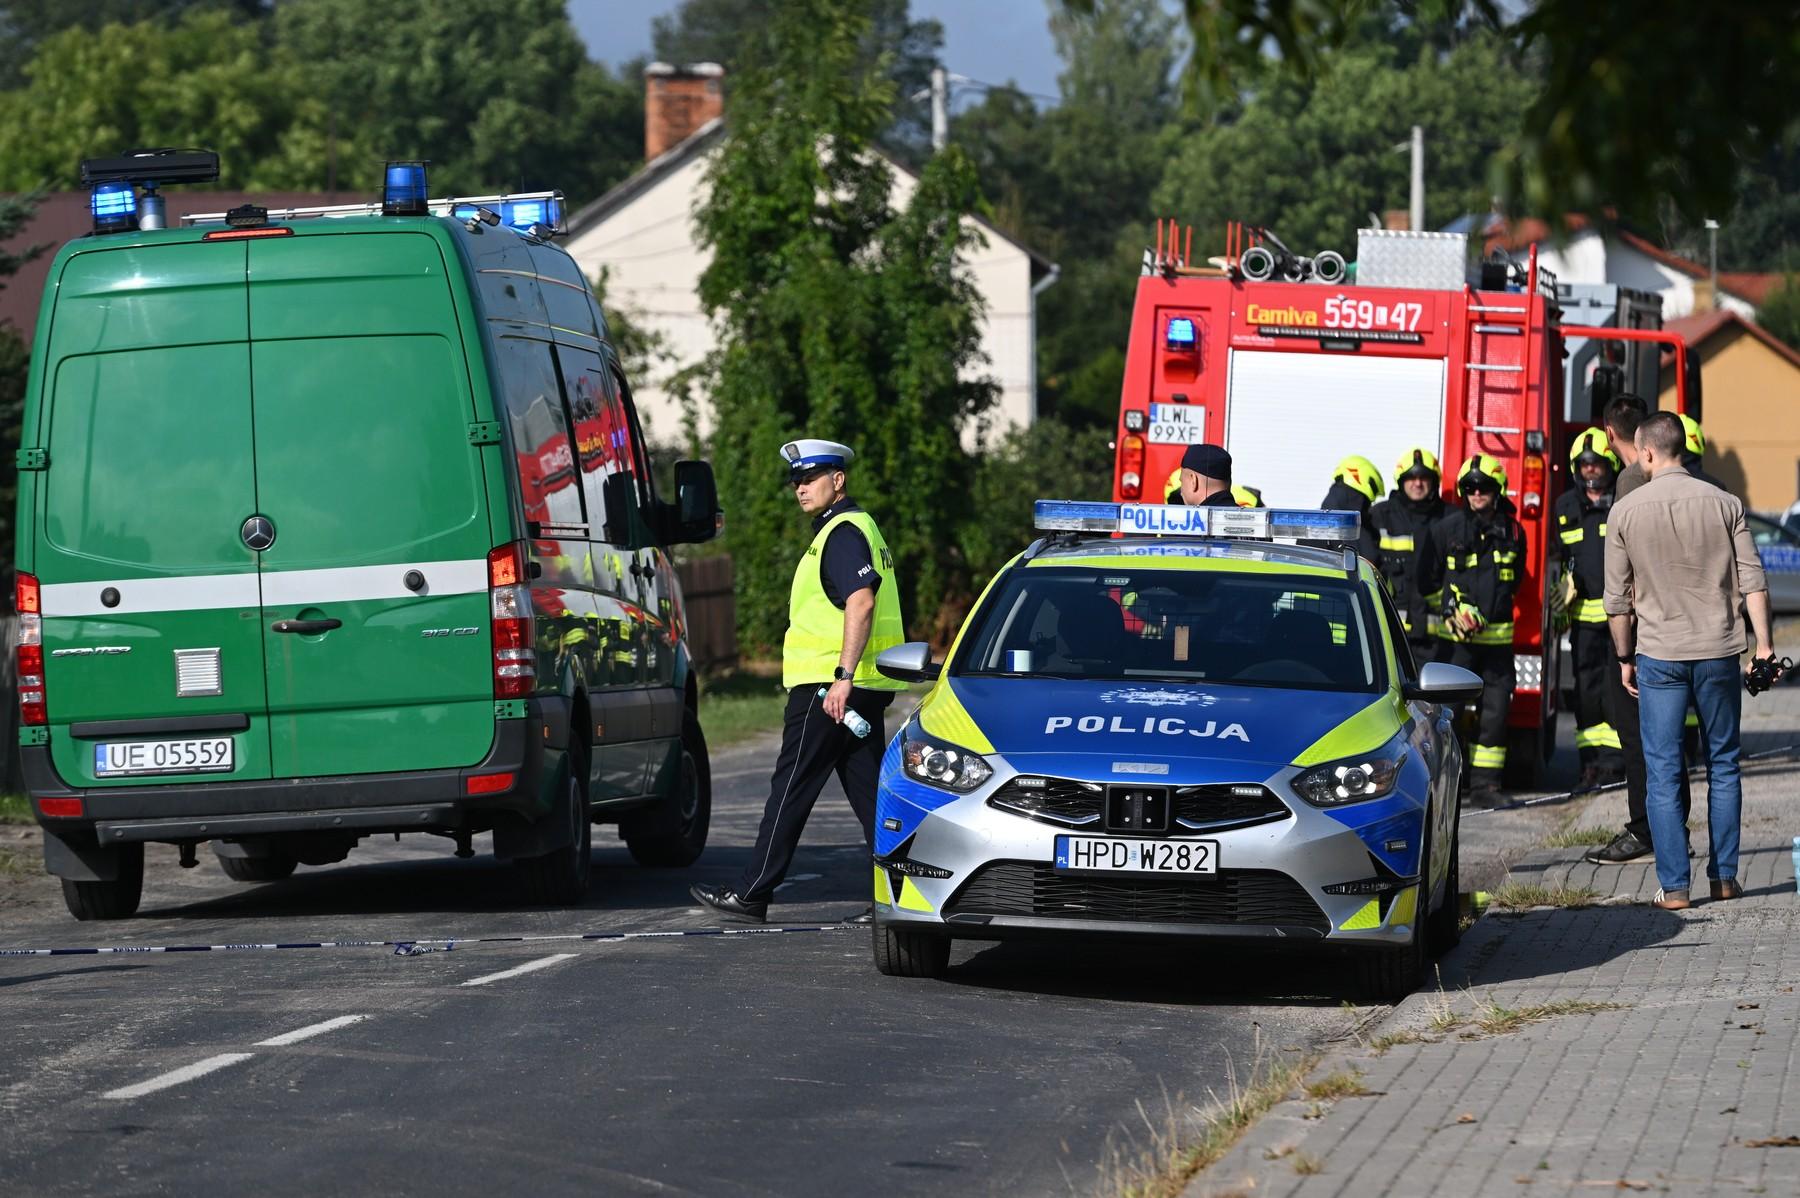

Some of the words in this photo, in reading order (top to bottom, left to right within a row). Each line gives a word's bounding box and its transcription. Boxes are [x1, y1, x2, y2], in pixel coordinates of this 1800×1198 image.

[1247, 304, 1318, 325] Camiva
[1324, 298, 1373, 329] 559
[1390, 302, 1422, 332] 47
[1162, 407, 1191, 423] LWL
[1154, 425, 1199, 441] 99XF
[1044, 716, 1250, 742] POLICJA
[111, 745, 145, 768] UE
[153, 741, 228, 766] 05559
[1057, 856, 1068, 864] PL
[1074, 841, 1128, 868] HPD
[1140, 843, 1209, 871] W282
